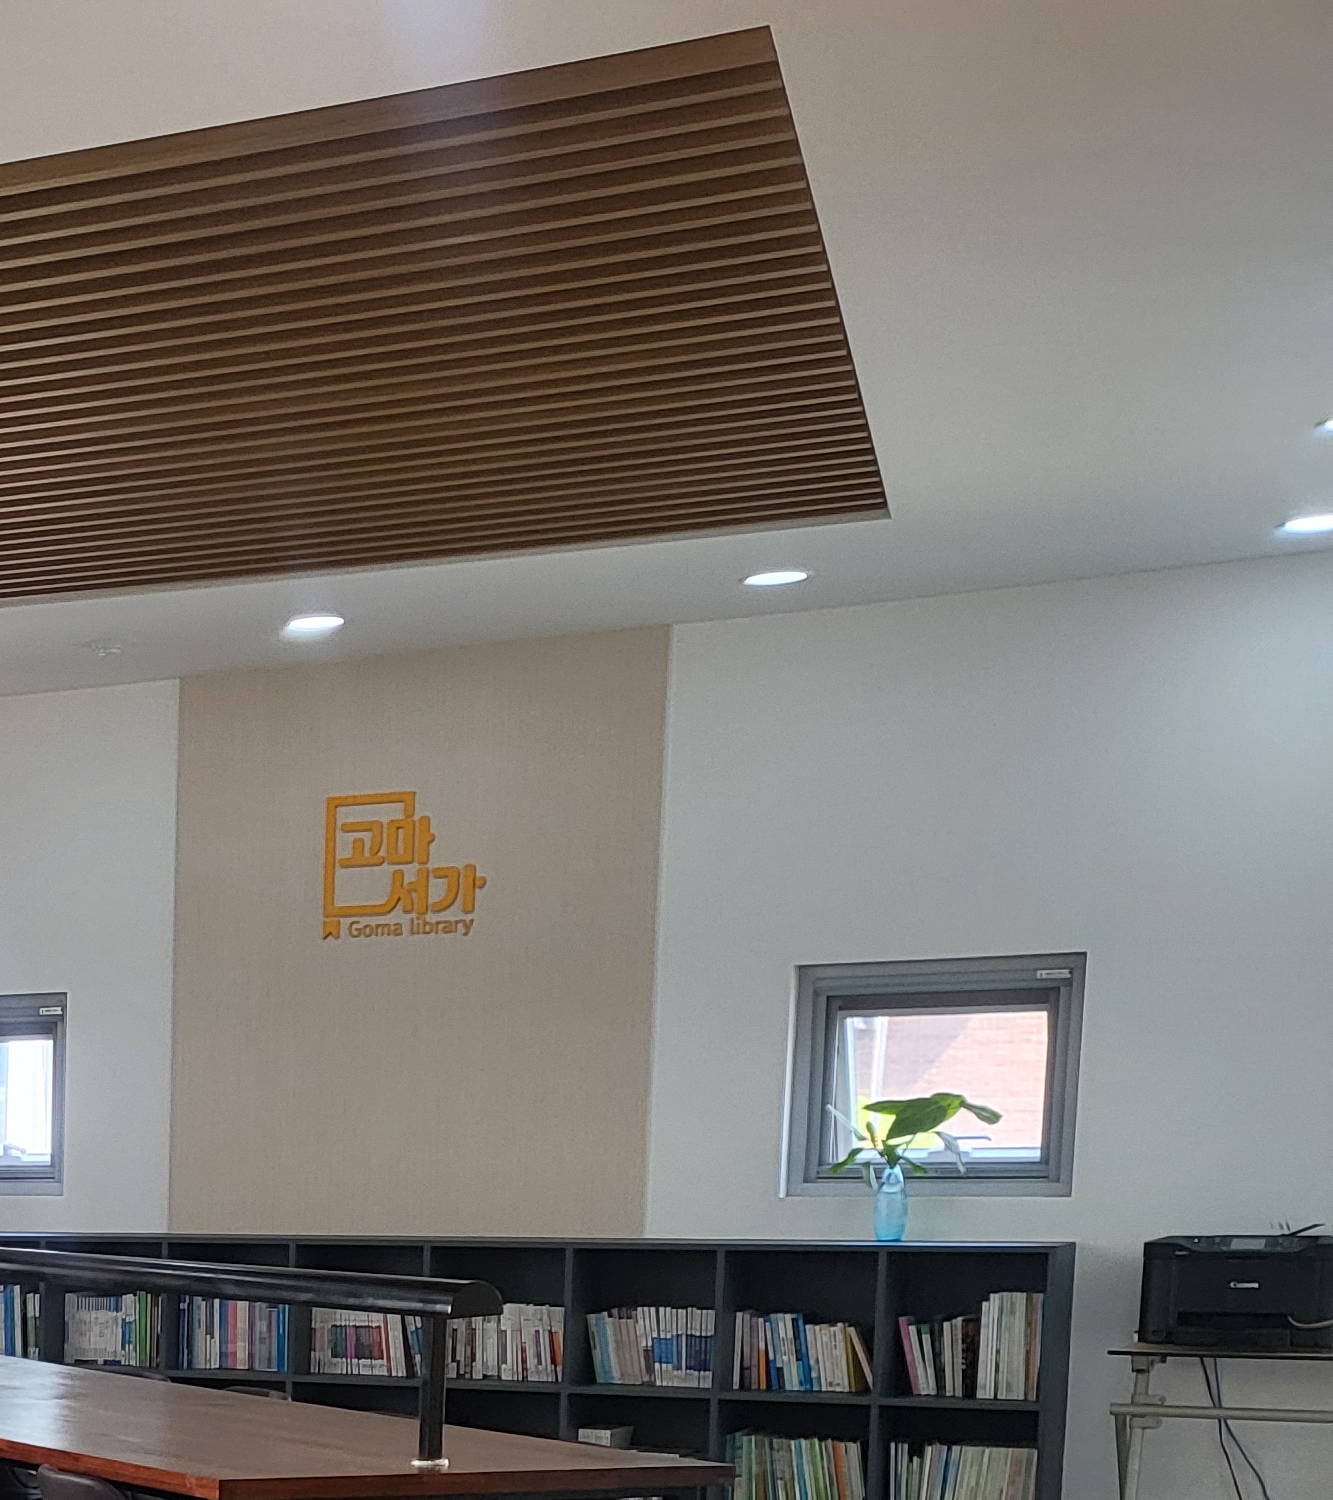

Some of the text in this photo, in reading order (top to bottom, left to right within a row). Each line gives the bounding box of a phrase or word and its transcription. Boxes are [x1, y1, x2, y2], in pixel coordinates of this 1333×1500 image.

[338, 816, 436, 868] 고마
[385, 863, 488, 915] 서가
[347, 917, 474, 939] Goma library
